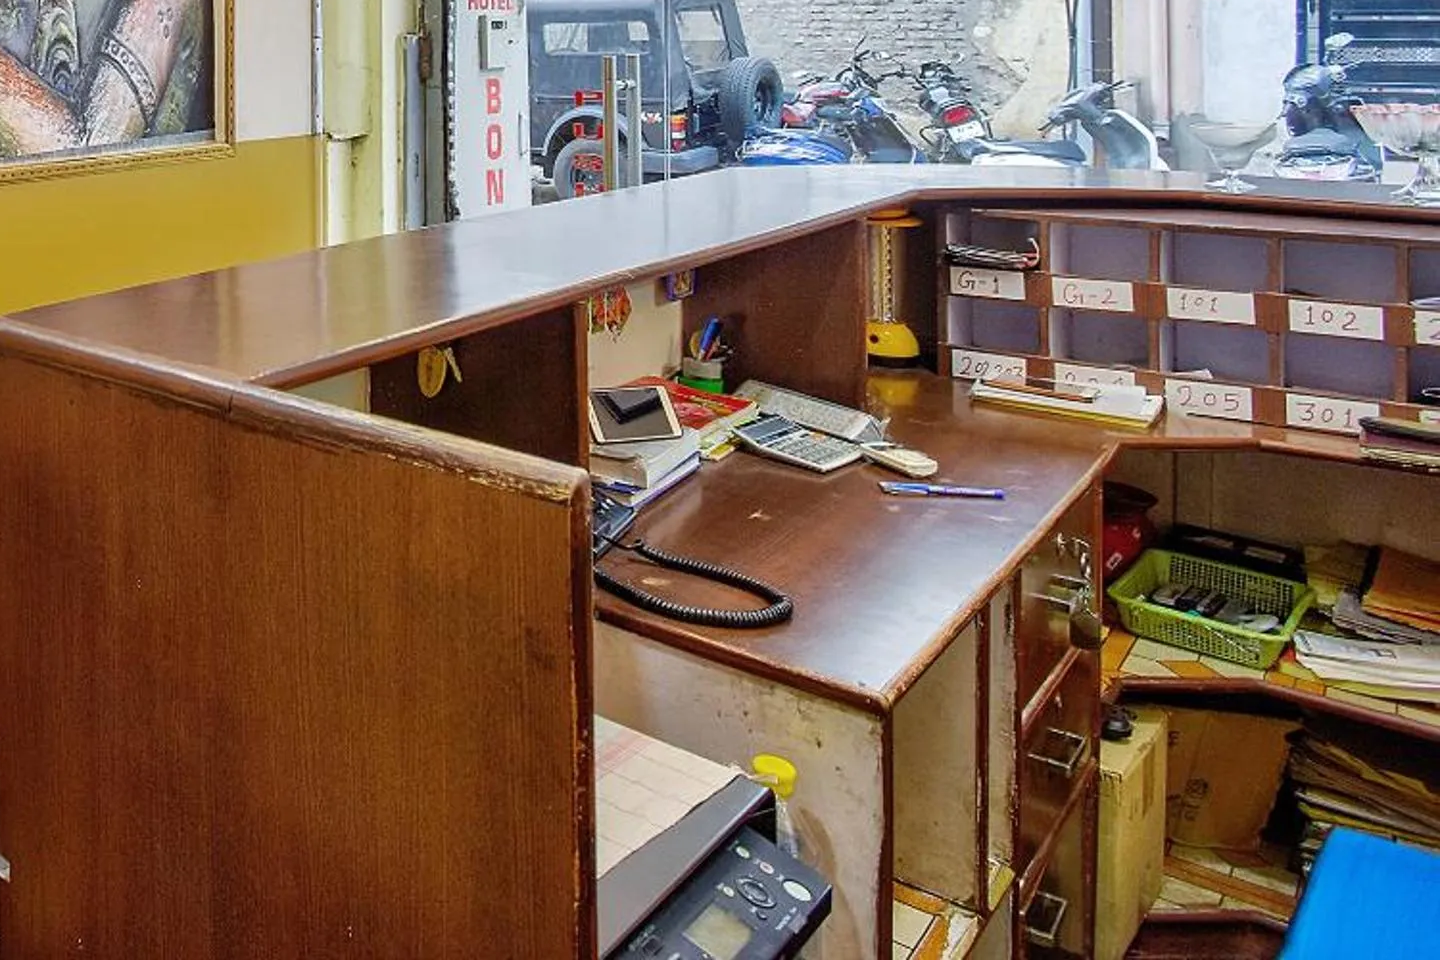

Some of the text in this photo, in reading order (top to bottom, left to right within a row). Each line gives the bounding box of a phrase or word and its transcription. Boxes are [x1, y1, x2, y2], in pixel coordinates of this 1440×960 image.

[1179, 292, 1219, 314] 101
[1304, 305, 1359, 331] 102
[1176, 385, 1241, 411] 205
[1295, 402, 1356, 428] 301
